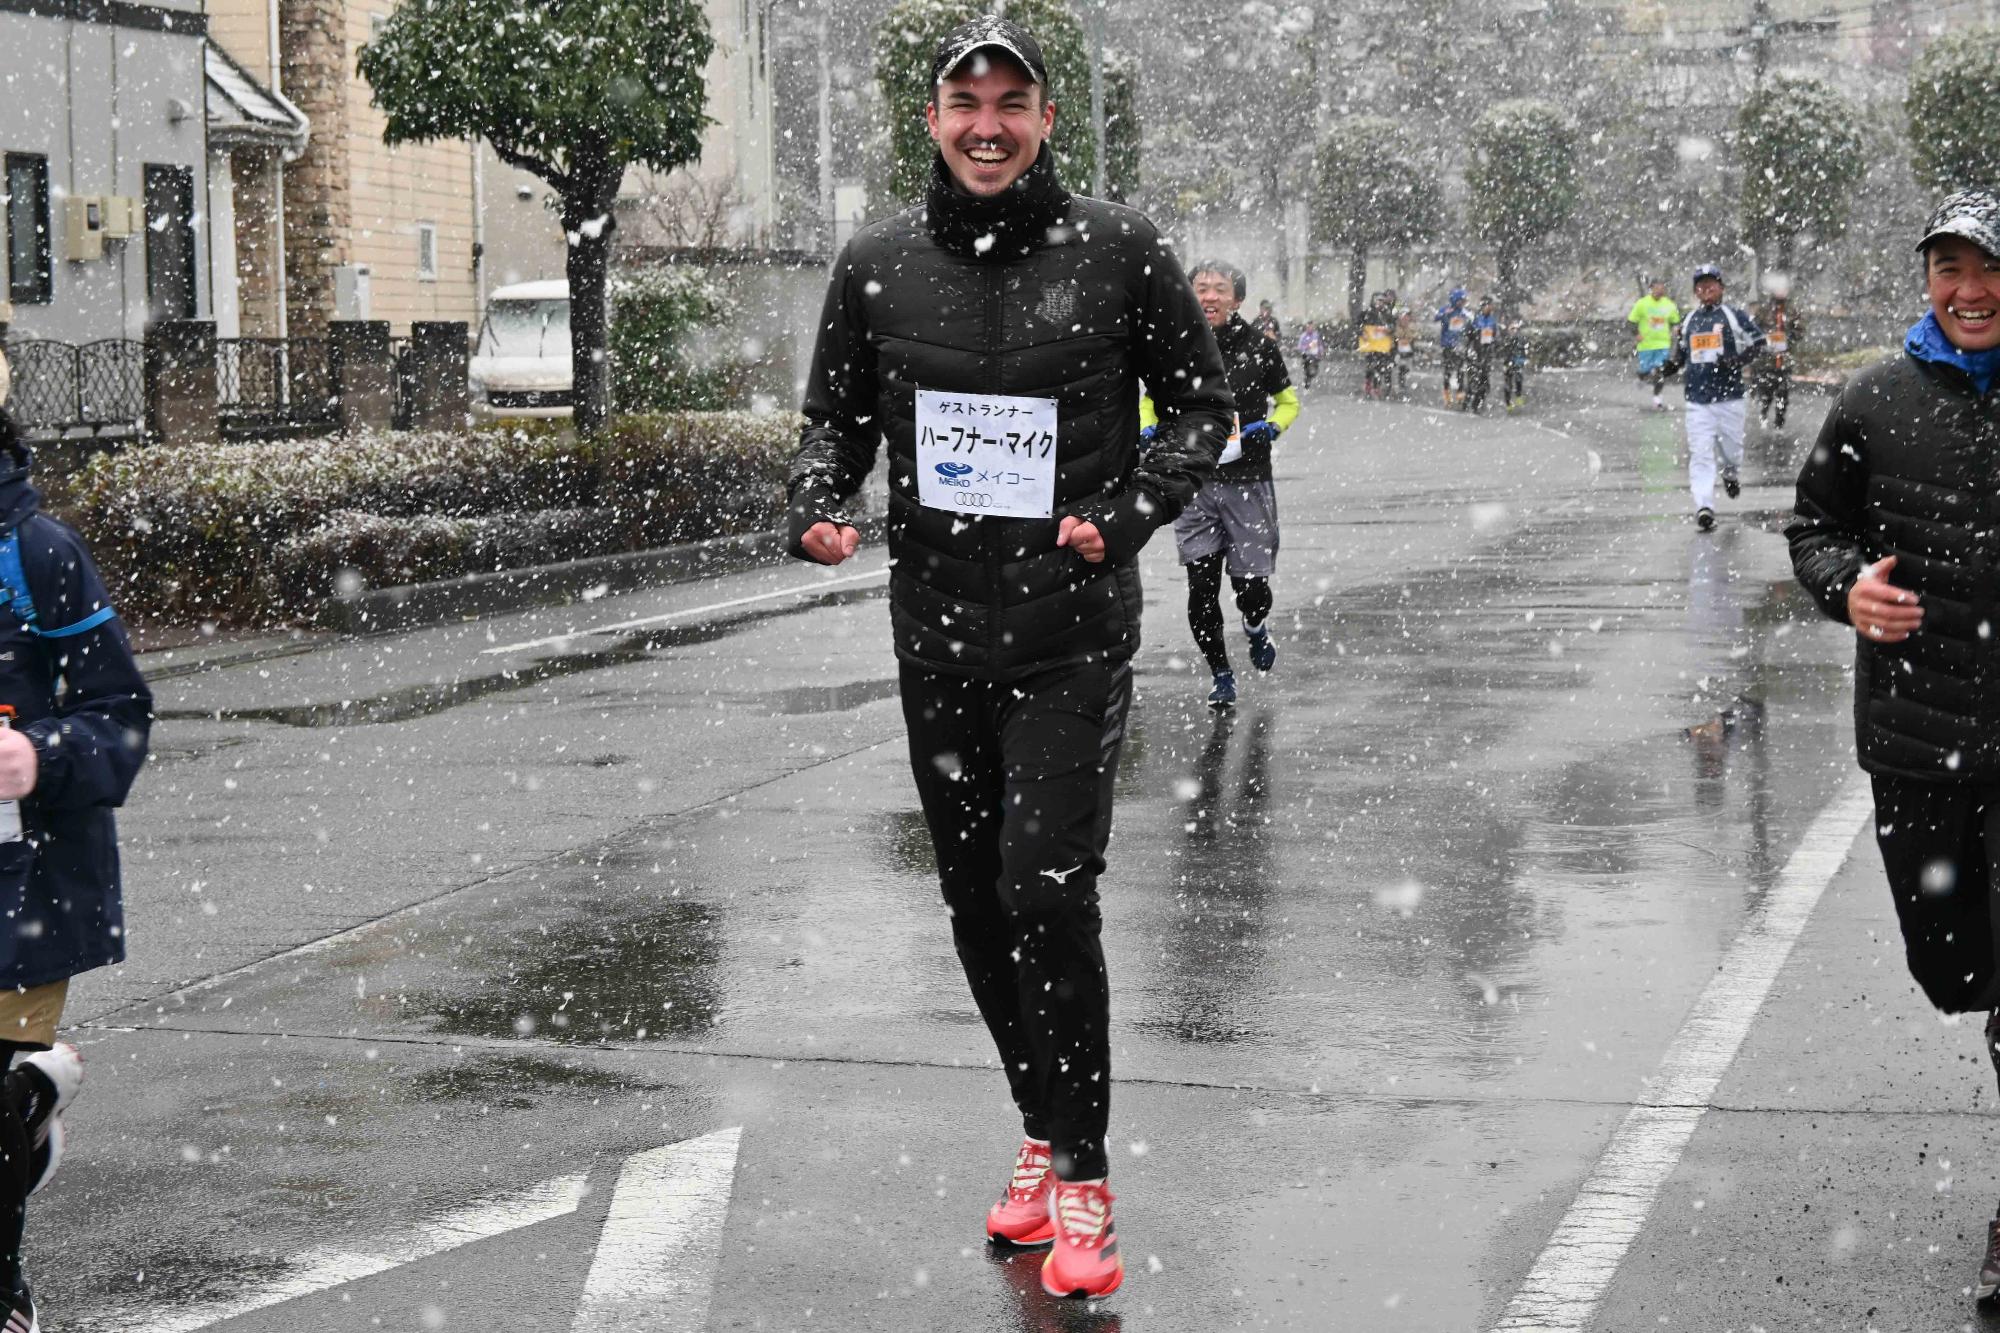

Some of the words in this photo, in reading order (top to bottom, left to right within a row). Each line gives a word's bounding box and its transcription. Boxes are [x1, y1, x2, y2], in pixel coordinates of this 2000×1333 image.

[939, 401, 1033, 418] ゲストランナー
[921, 426, 1053, 459] ハーフナー・マイク
[938, 477, 971, 488] MEIKO
[976, 470, 1036, 485] メイコー
